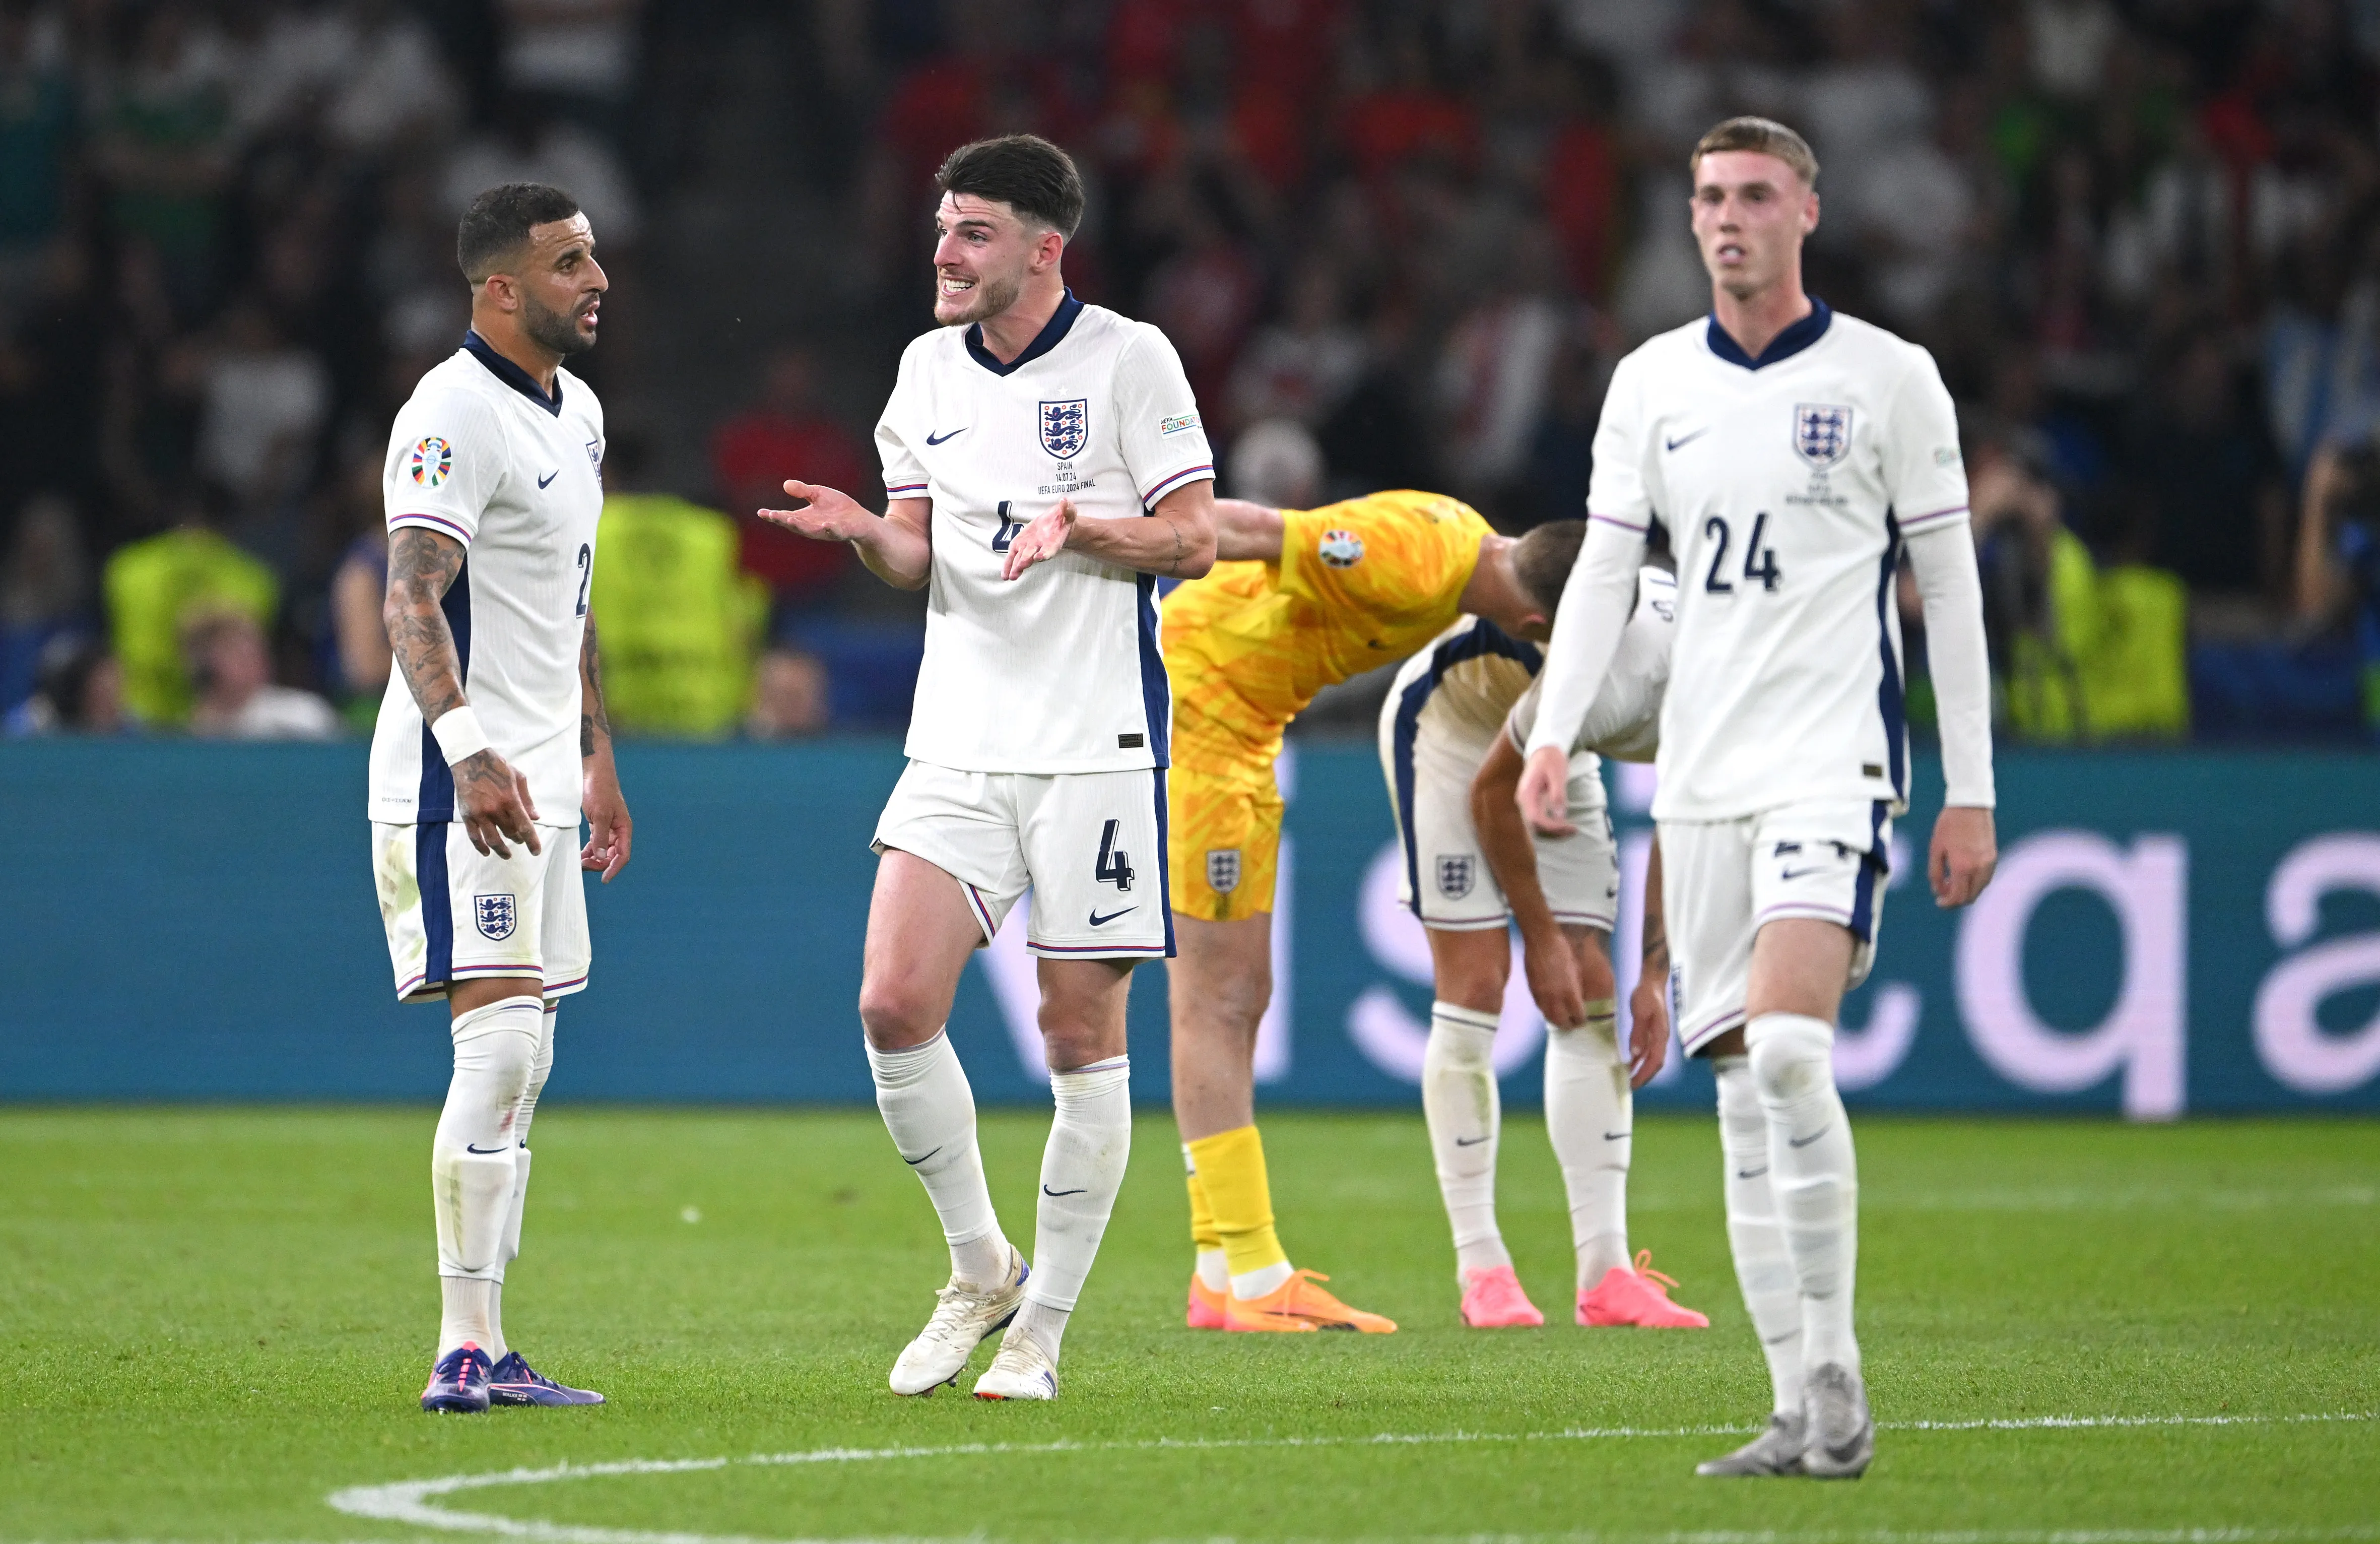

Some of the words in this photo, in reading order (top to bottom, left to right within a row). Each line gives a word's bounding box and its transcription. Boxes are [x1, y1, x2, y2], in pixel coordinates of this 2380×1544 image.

[1038, 486, 1050, 495] UEFA
[1052, 484, 1065, 493] EURO
[1067, 483, 1079, 492] 2024
[1081, 479, 1096, 489] FINAL
[1055, 472, 1077, 482] 14.07.24
[1057, 462, 1073, 471] SPAIN
[1705, 512, 1781, 594] 24
[576, 542, 591, 619] 2
[1095, 819, 1135, 891] 4
